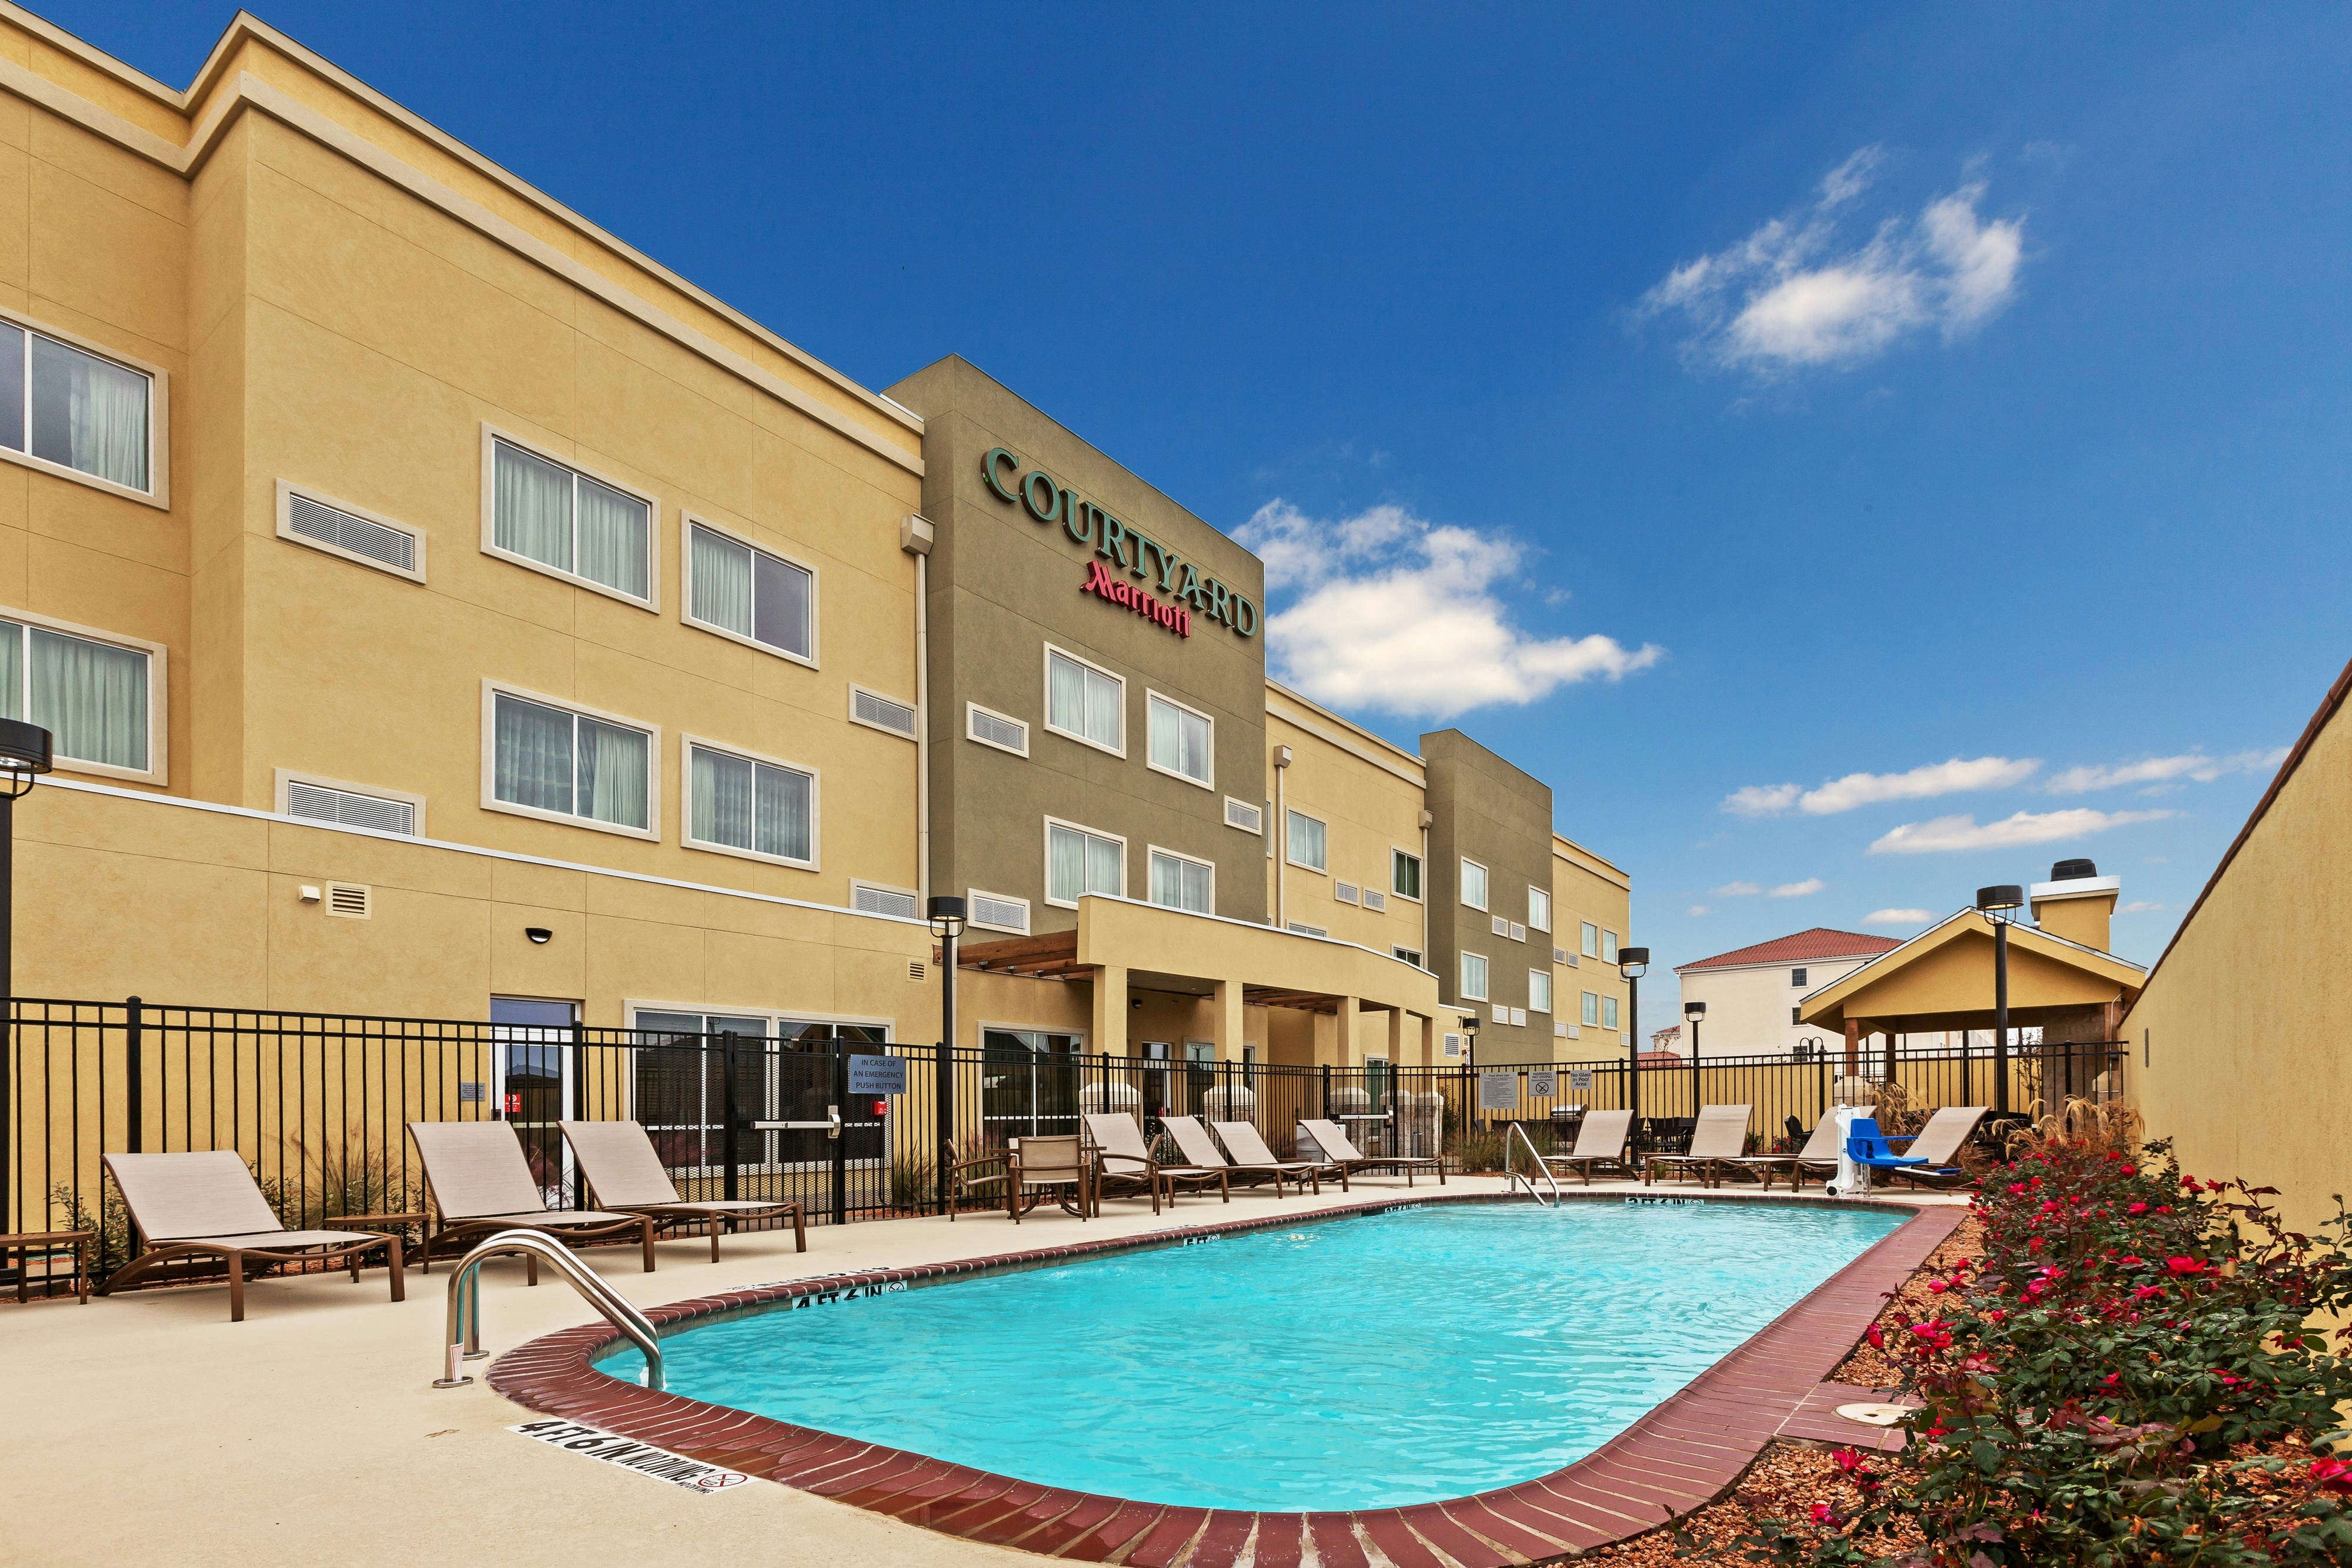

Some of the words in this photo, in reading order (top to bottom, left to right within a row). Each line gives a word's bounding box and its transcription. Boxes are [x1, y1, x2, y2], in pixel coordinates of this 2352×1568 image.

[980, 447, 1258, 637] COURTYARD
[1080, 560, 1191, 638] Marriott
[1197, 1236, 1208, 1245] FT
[796, 1296, 811, 1309] 4
[818, 1291, 839, 1305] FT
[844, 1288, 860, 1300] 6
[865, 1285, 882, 1298] IN
[518, 1421, 567, 1433] 4
[564, 1437, 622, 1449] 6
[617, 1452, 670, 1466] NO
[635, 1457, 716, 1481] DIVING
[685, 1483, 714, 1494] DIVING
